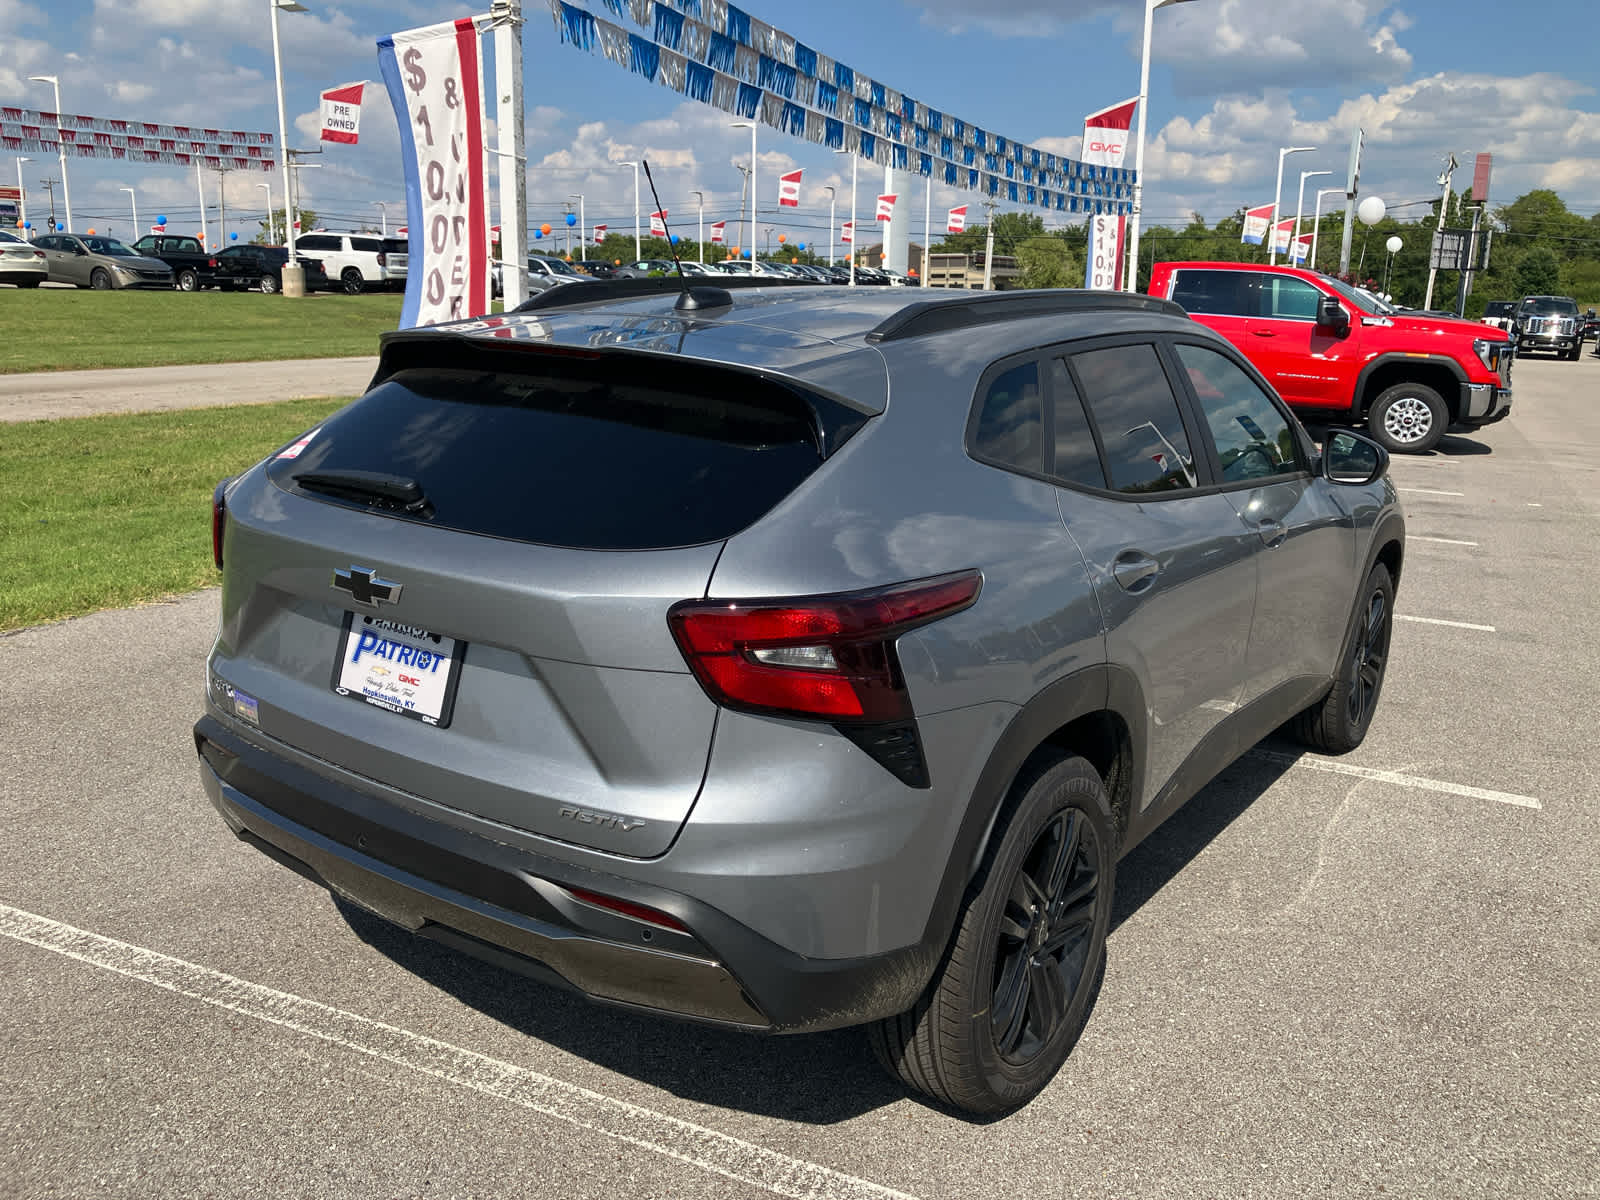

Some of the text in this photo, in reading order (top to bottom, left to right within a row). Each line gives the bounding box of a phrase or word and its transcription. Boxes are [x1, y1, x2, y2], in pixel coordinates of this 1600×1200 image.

[444, 77, 459, 109] &
[334, 105, 350, 116] PRE
[327, 118, 355, 130] OWNED
[1090, 142, 1121, 154] GMC
[403, 46, 450, 326] $10,00
[352, 628, 446, 673] PATRIOT
[398, 674, 420, 686] GMC
[362, 687, 403, 707] Hopkinsville,
[404, 700, 416, 709] KY
